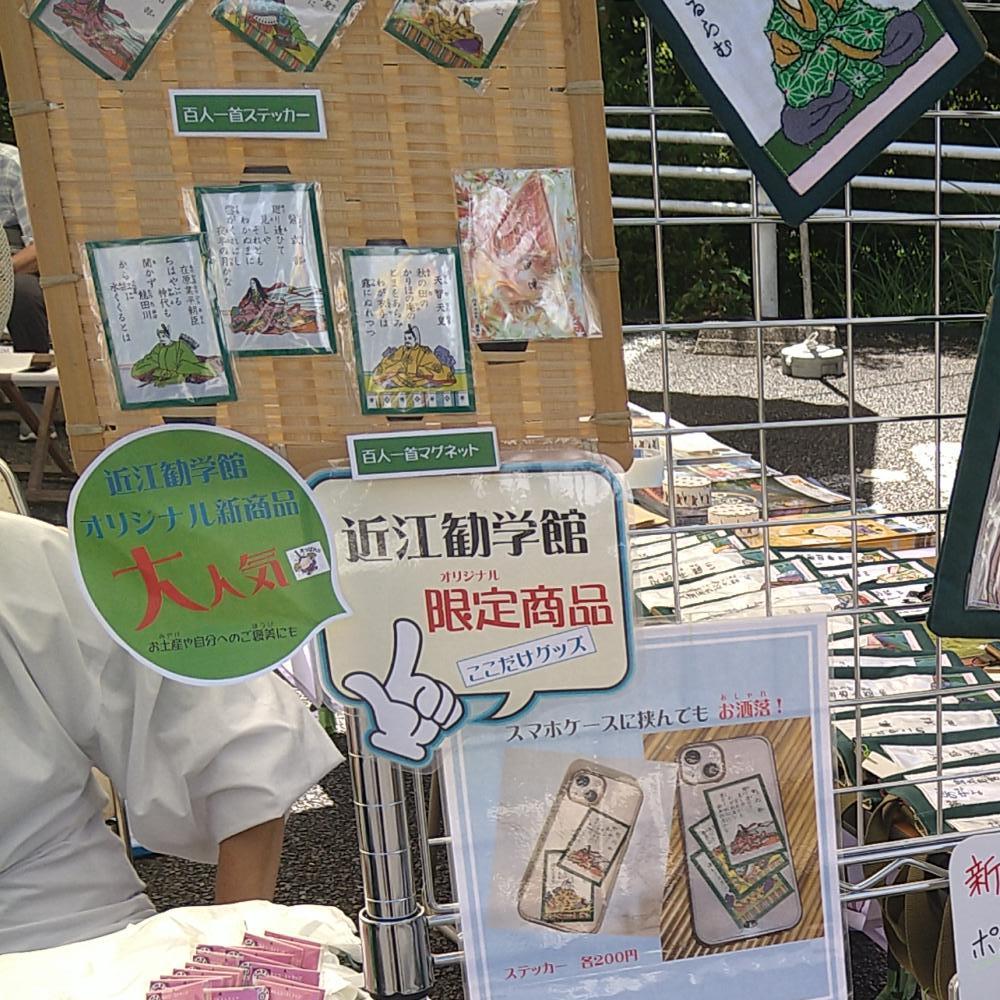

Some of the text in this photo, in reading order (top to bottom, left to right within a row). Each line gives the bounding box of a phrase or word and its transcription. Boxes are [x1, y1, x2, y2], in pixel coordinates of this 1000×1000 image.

[183, 106, 311, 125] 百人一首ステッカー
[104, 453, 248, 497] 近江勧学館
[361, 444, 479, 465] 百人一首マグネット
[79, 489, 300, 539] オリジナル新商品
[341, 509, 588, 562] 近江勧学館
[112, 546, 288, 631] 大人気
[440, 569, 500, 583] オリジナル
[424, 584, 614, 633] 限定商品
[148, 626, 298, 653] お土産や自分へのご褒美にも
[466, 634, 587, 683] ここだけグッズ
[504, 948, 640, 982] ステッカー 各200円
